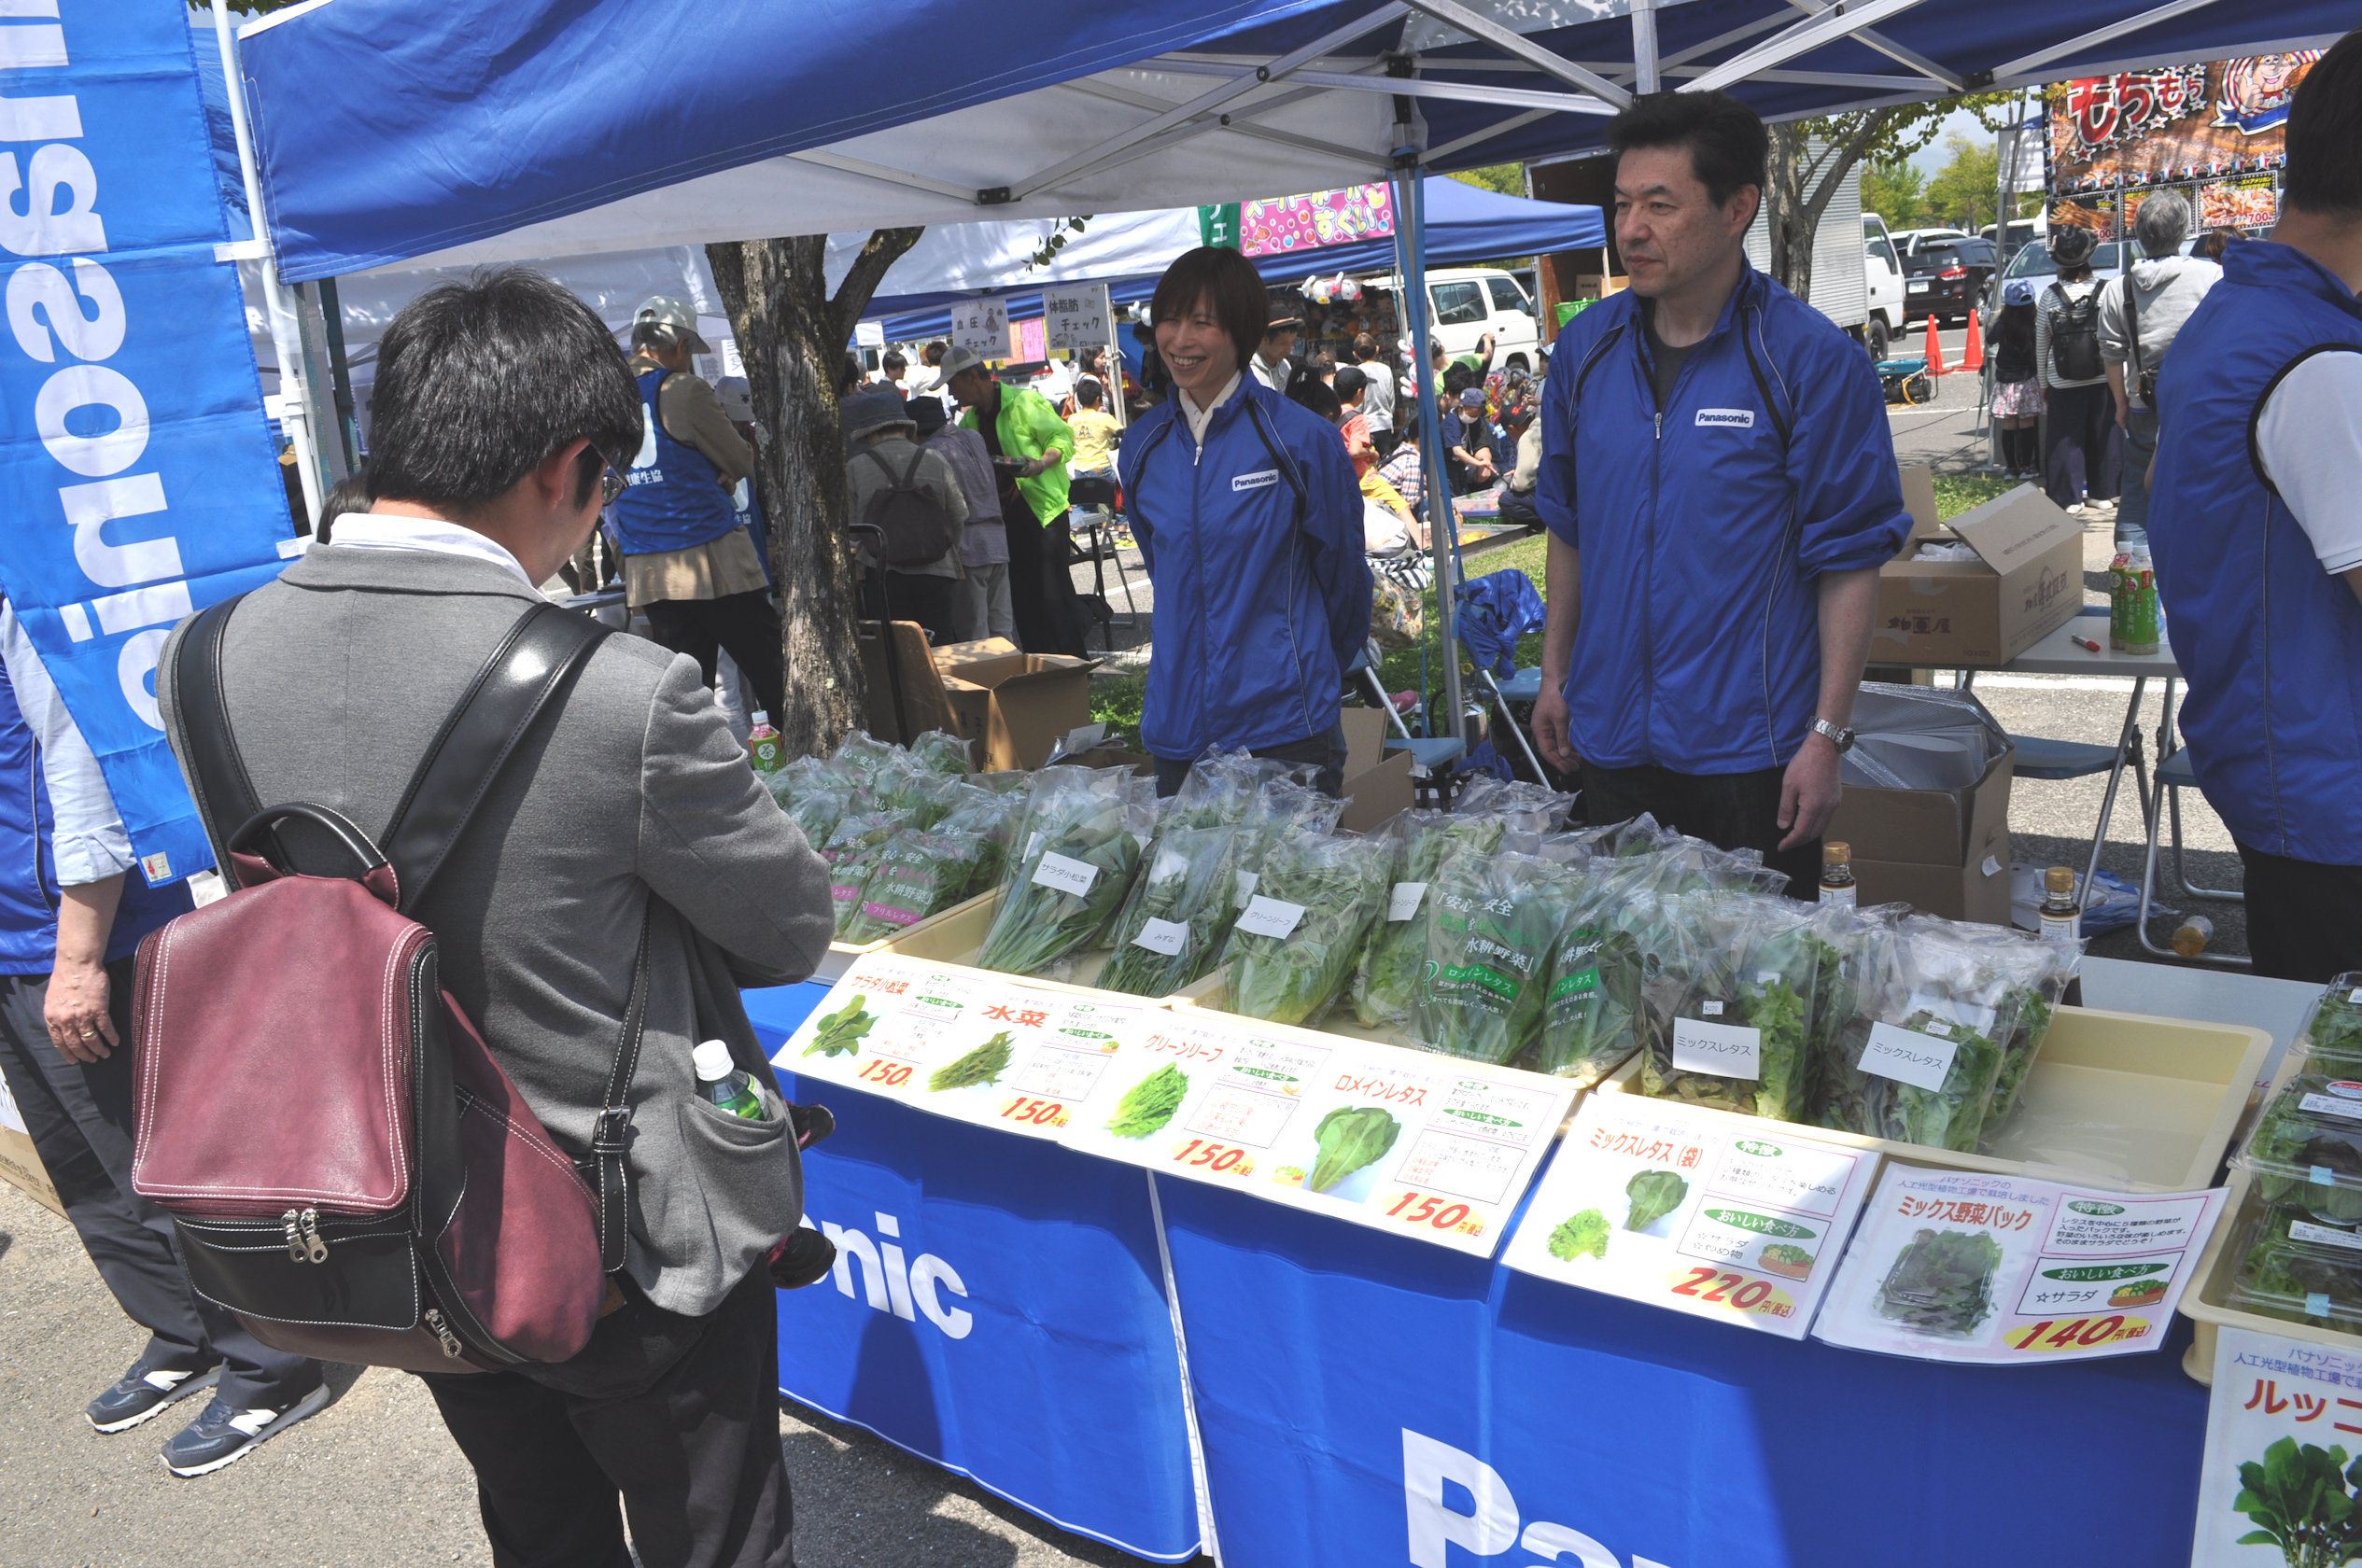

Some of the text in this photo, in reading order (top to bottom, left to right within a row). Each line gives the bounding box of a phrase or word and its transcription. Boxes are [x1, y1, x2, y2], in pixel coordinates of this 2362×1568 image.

[1314, 205, 1377, 242] すくい
[1049, 299, 1078, 314] 体脂肪
[957, 316, 978, 330] 血圧
[1061, 316, 1100, 331] チェック
[964, 335, 997, 346] チェック
[1698, 413, 1750, 424] Panasonic
[1234, 473, 1277, 487] Panasonic
[1041, 863, 1088, 884] サラダ小松菜
[1436, 892, 1514, 917] 「安心安全
[1250, 911, 1291, 926] グリーンリーフ
[1467, 937, 1535, 973] 水耕野菜」
[851, 974, 910, 996] サラダ小松菜
[1448, 967, 1512, 993] ロメインレタス
[981, 1005, 1049, 1028] 水菜
[1145, 1034, 1224, 1062] グリーンリーフ
[1677, 1035, 1751, 1057] ミックスレタス
[1874, 1042, 1943, 1070] ミックスレタス
[1335, 1074, 1427, 1107] ロメインレタス
[1453, 1109, 1512, 1127] おいしい食べ方
[1940, 1176, 2012, 1190] パナソニックの
[1898, 1196, 2032, 1231] ミックス野菜パック
[2074, 1200, 2117, 1215] 特徴
[1717, 1210, 1800, 1238] おいしい食べ方
[799, 1211, 973, 1339] nic
[2059, 1265, 2152, 1281] おいしい食べ方
